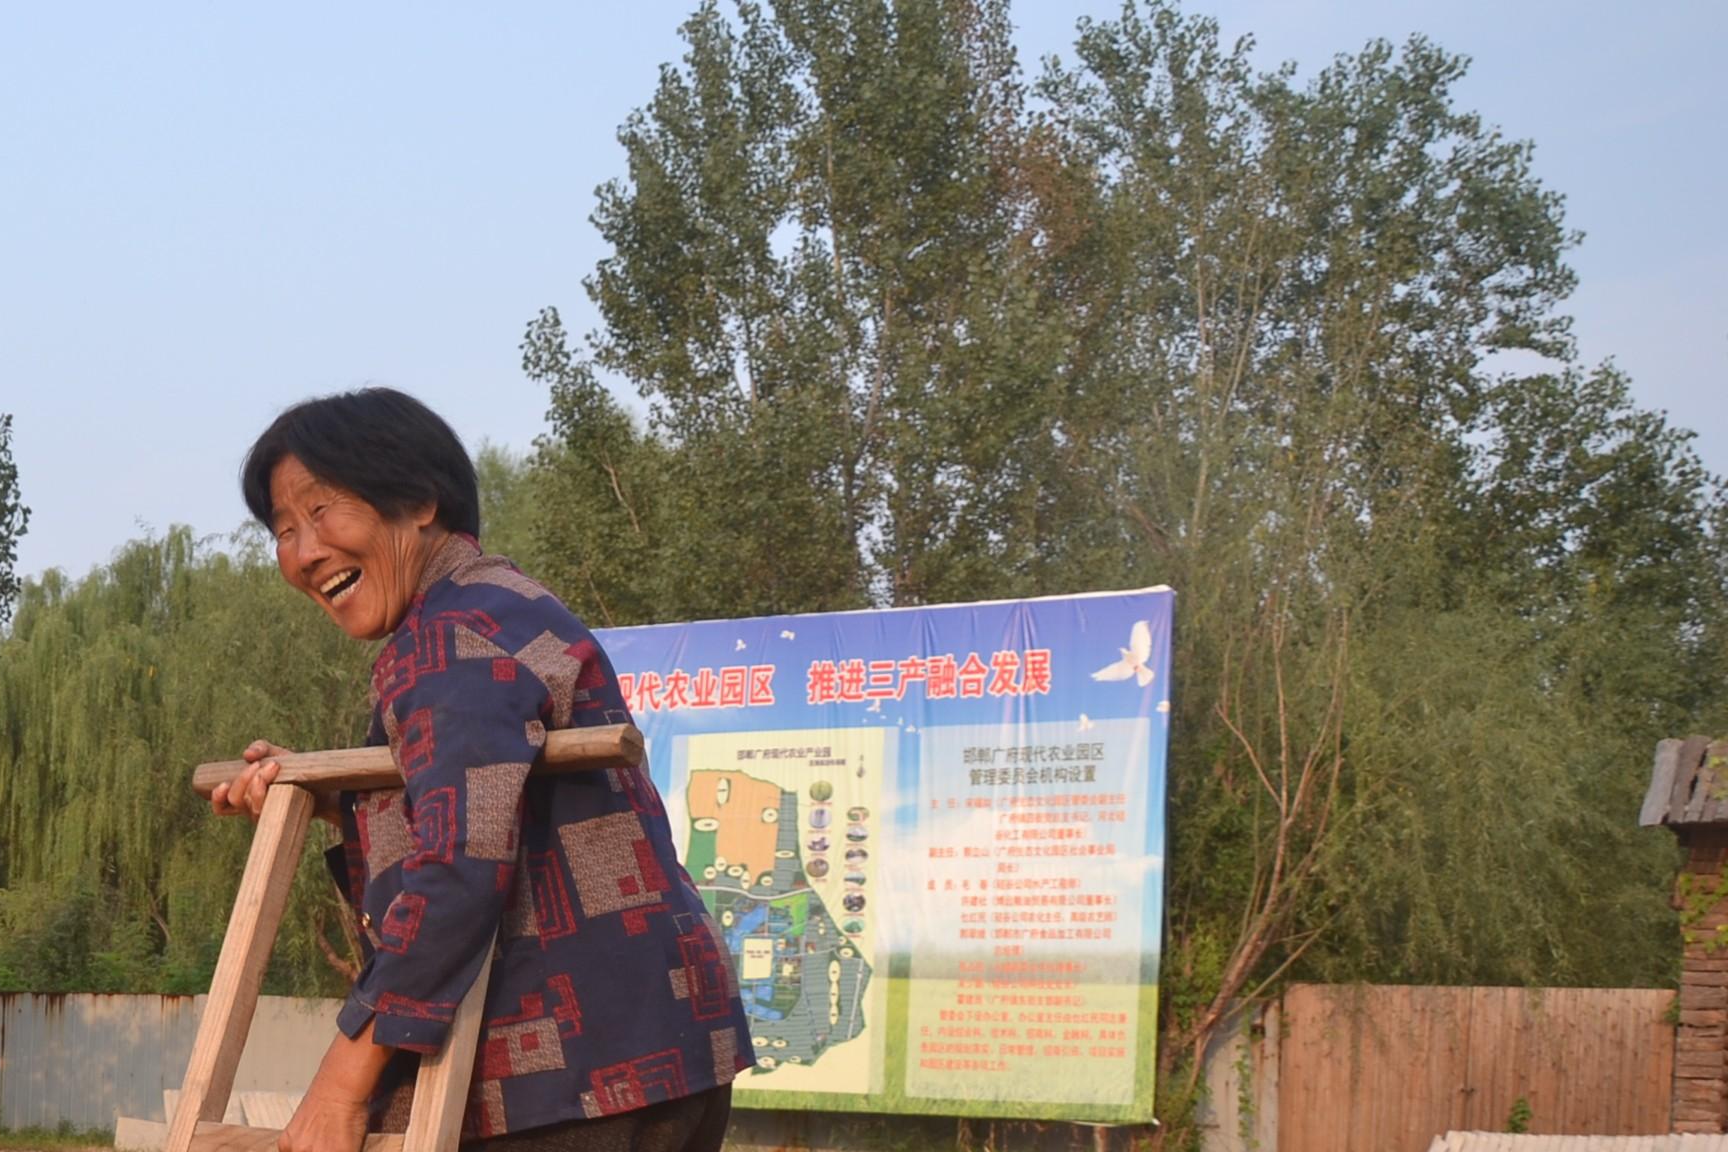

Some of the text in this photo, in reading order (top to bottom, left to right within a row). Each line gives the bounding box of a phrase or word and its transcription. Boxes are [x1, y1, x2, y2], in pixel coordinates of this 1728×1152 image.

[808, 650, 1051, 704] 推进三产融合发展
[963, 743, 1104, 764] 邯郸广府现代农业园区
[969, 765, 1096, 785] 管理委员会机构设置
